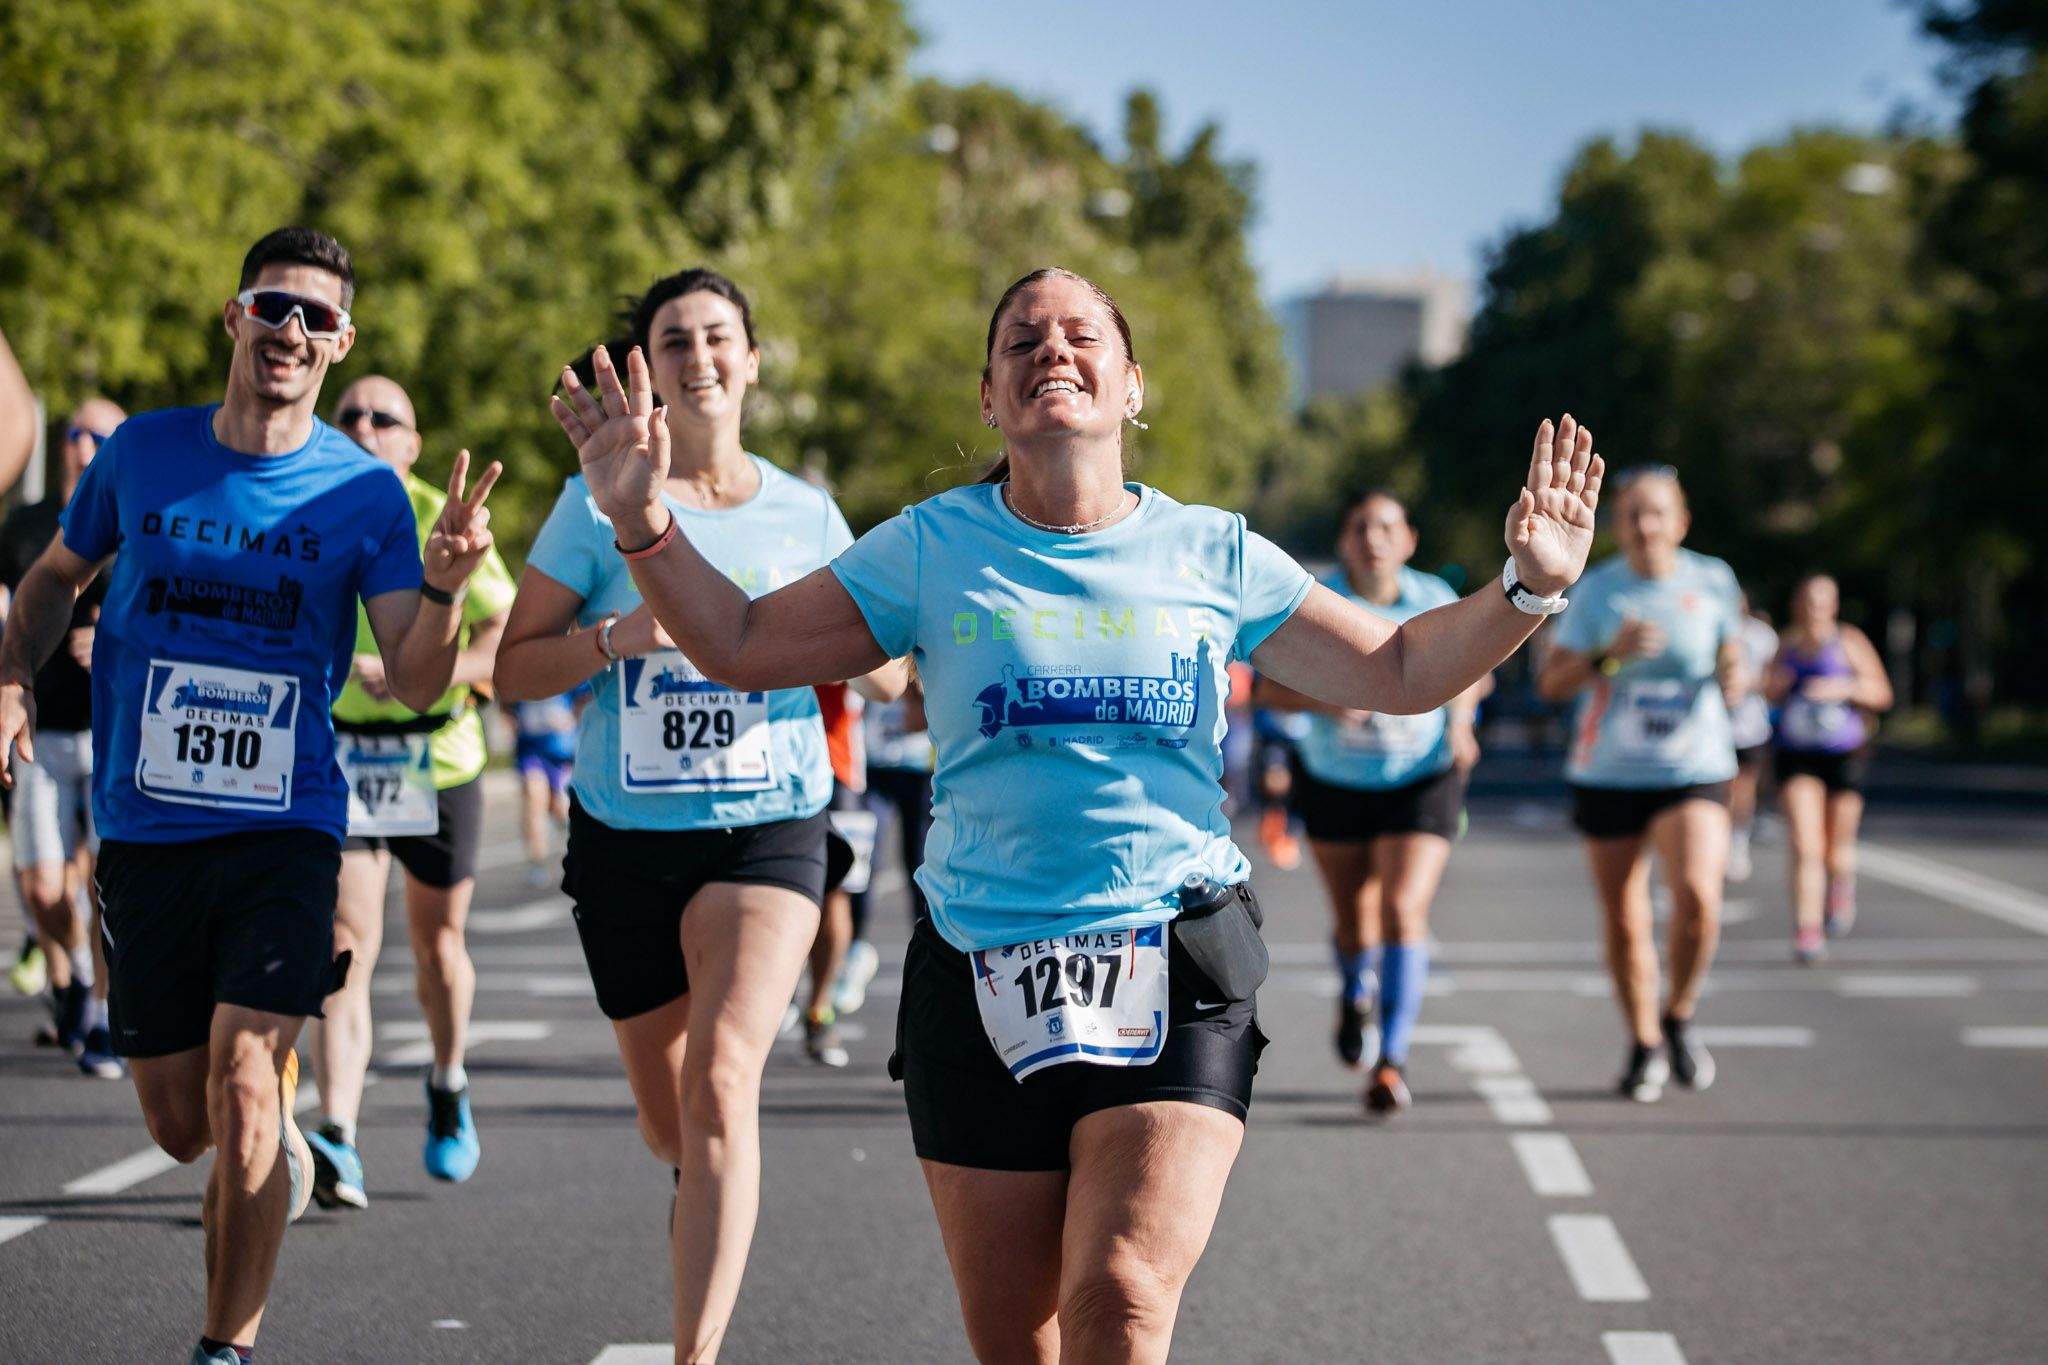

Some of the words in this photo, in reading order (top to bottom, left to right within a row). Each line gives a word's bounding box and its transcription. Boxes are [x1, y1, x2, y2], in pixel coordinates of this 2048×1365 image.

[142, 511, 321, 562] DECIMAS
[953, 608, 1212, 645] DECIMAS
[1027, 664, 1082, 675] CARRERA
[197, 686, 268, 705] BOMBEROS
[665, 694, 742, 707] DECIMAS
[1027, 678, 1195, 701] BOMBEROS
[186, 708, 265, 728] DECIMAS
[1095, 701, 1119, 721] de
[1125, 700, 1195, 726] MADRID
[662, 708, 735, 751] 829
[1063, 735, 1104, 745] MADRID
[173, 722, 262, 771] 1310
[1014, 953, 1122, 1019] 1297
